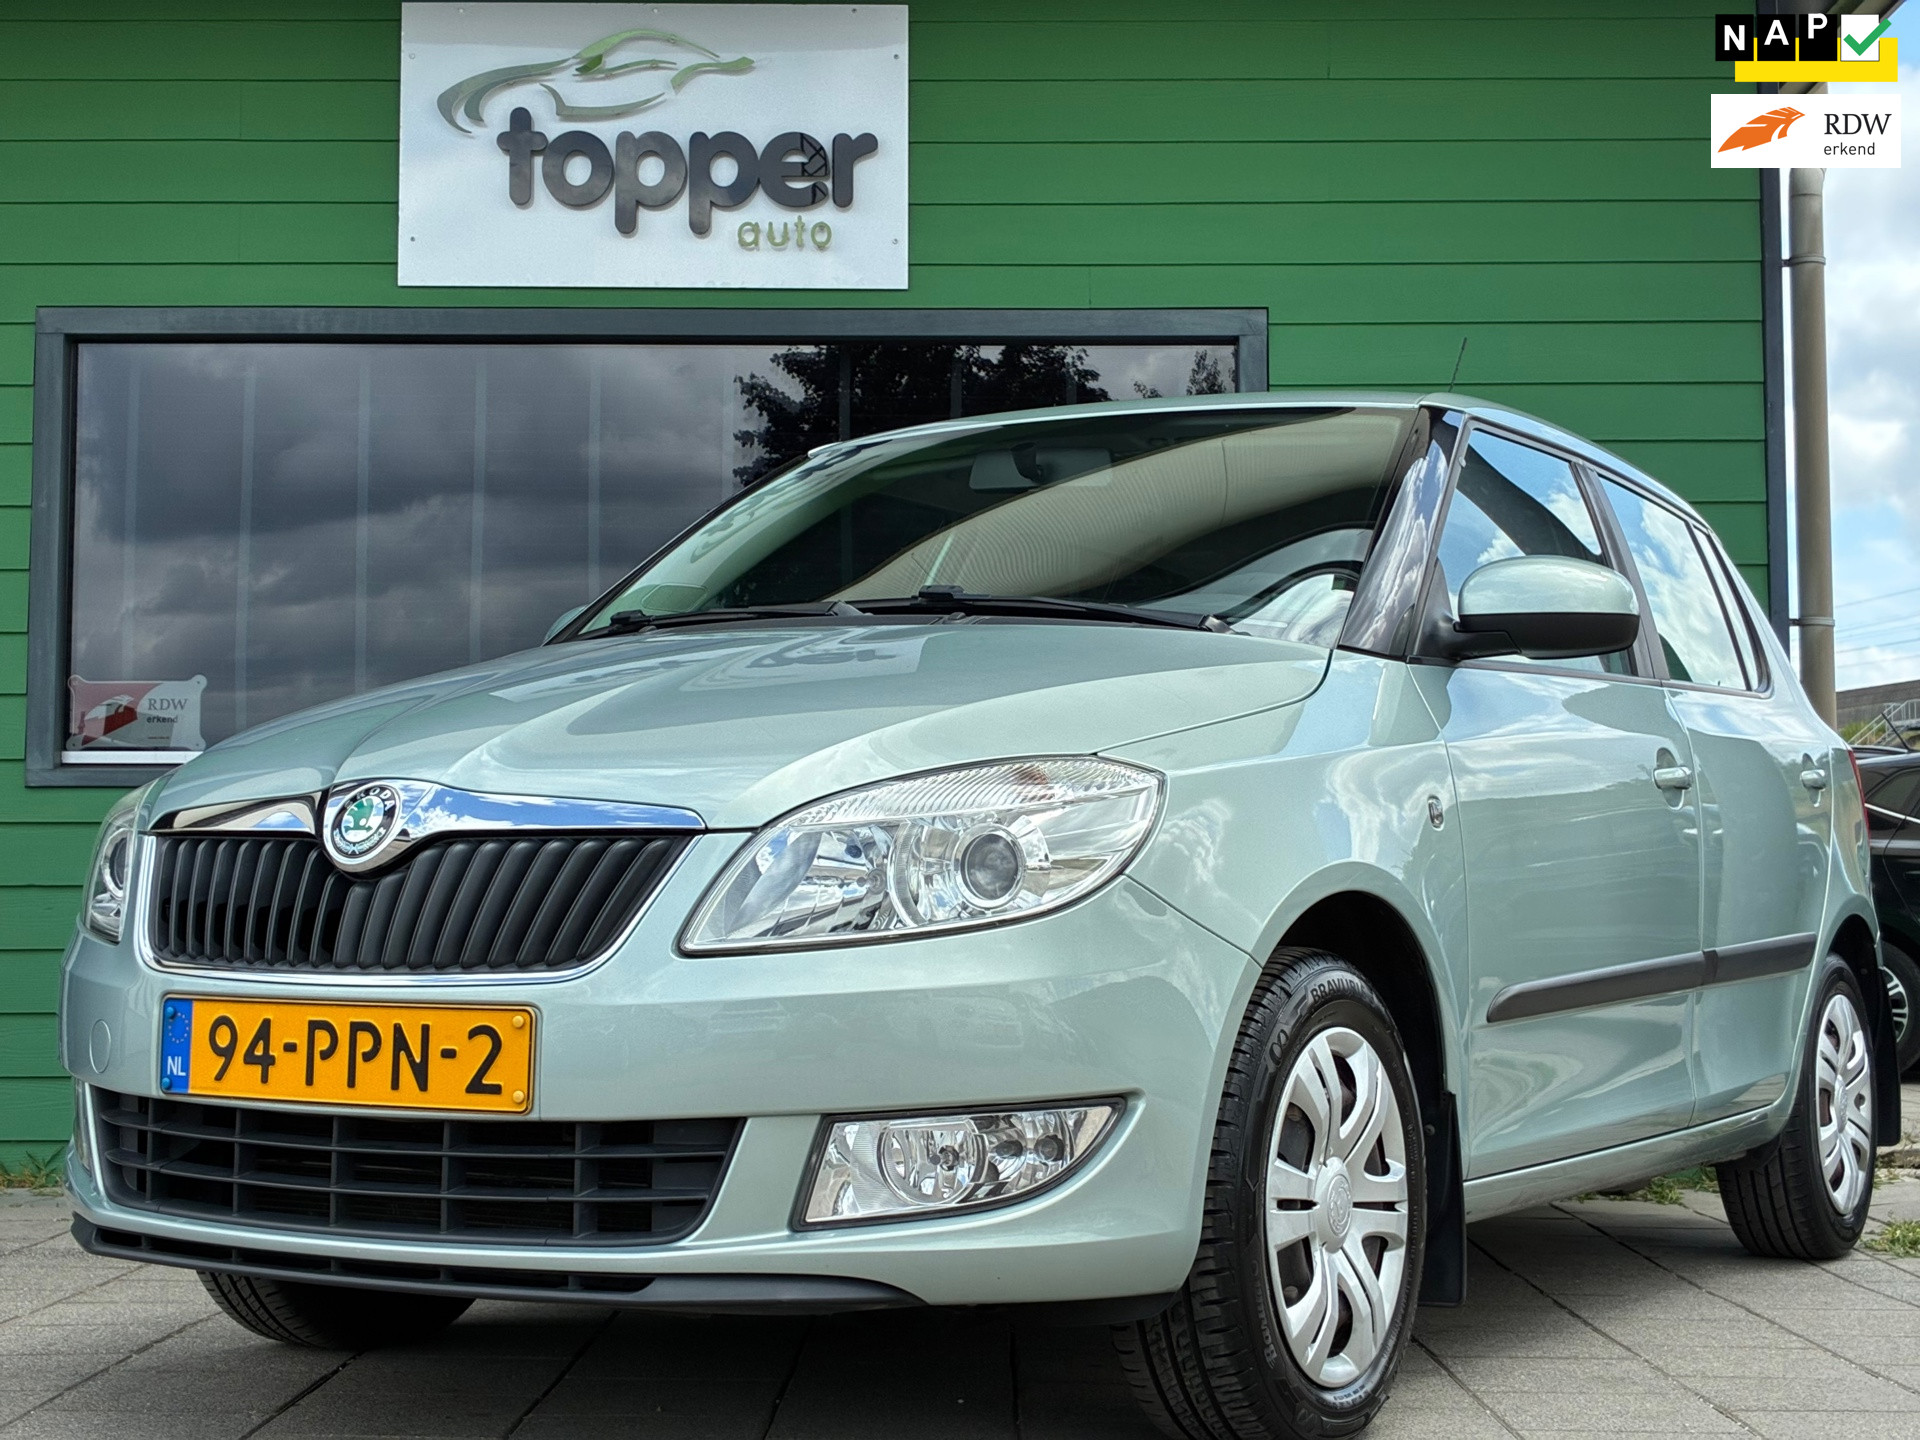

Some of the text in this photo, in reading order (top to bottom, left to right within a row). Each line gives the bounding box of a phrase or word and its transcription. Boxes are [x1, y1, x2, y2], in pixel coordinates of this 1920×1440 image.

[497, 107, 878, 235] topper
[737, 215, 832, 248] auto
[148, 698, 188, 710] RDW
[146, 714, 178, 723] erkend
[167, 1055, 186, 1077] NL
[208, 1014, 503, 1095] 94-PPN-2
